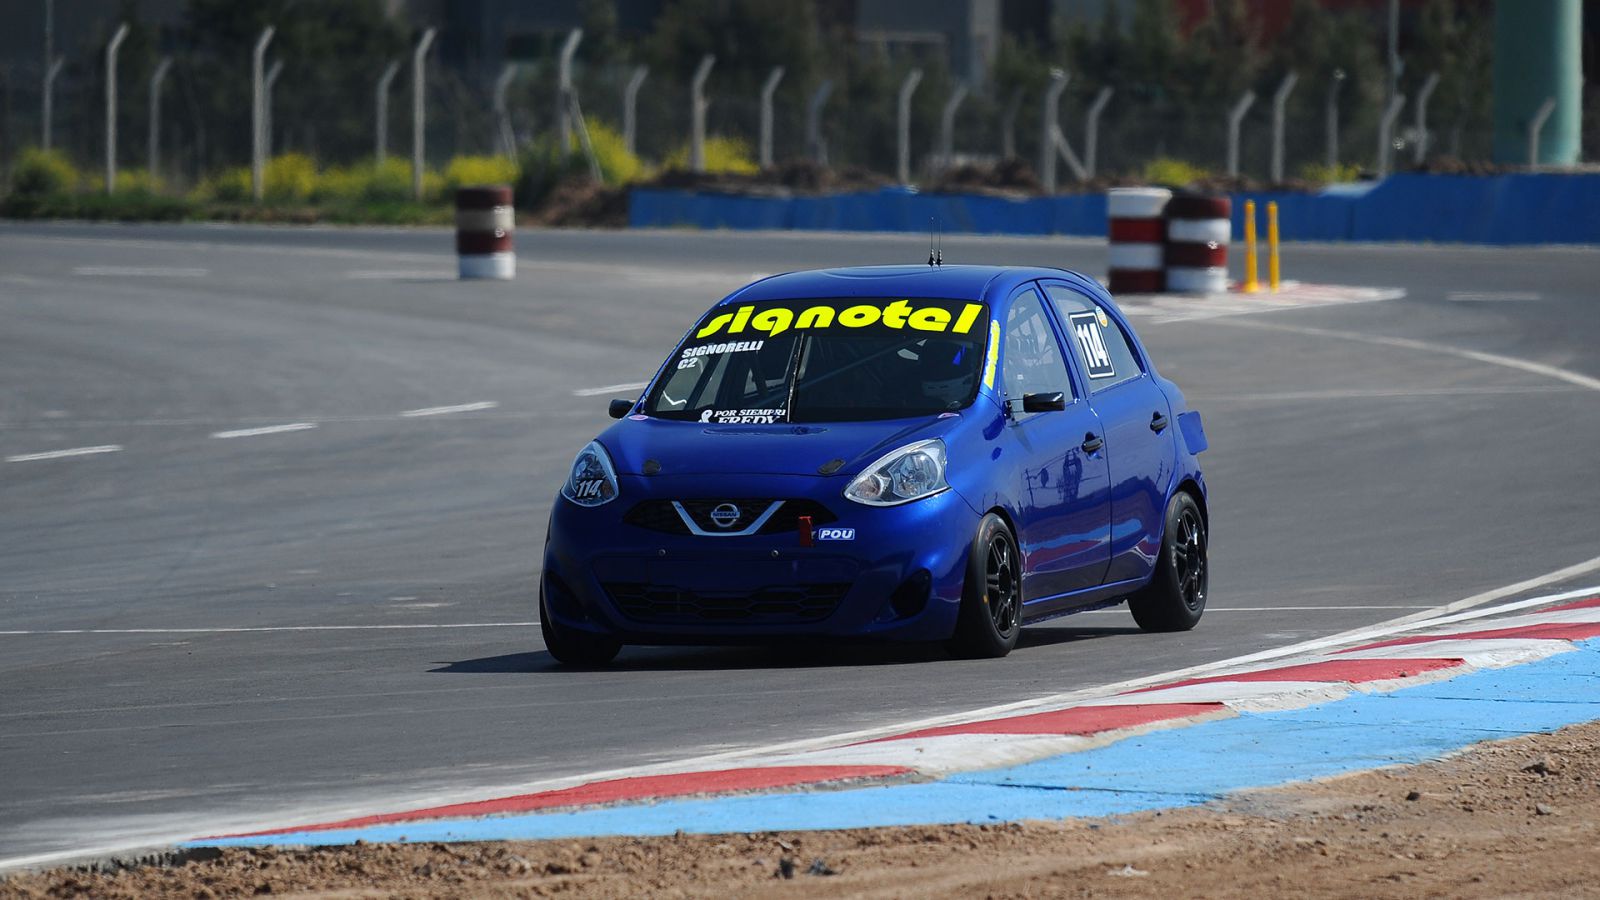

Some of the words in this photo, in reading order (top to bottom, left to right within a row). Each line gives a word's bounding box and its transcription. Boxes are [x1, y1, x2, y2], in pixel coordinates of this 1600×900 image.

[696, 300, 983, 338] signotel
[681, 340, 764, 359] SIGNORELLI
[1077, 323, 1109, 368] 114
[677, 357, 698, 370] C2
[713, 409, 738, 418] POR
[577, 479, 604, 498] 114
[820, 529, 853, 539] POU
